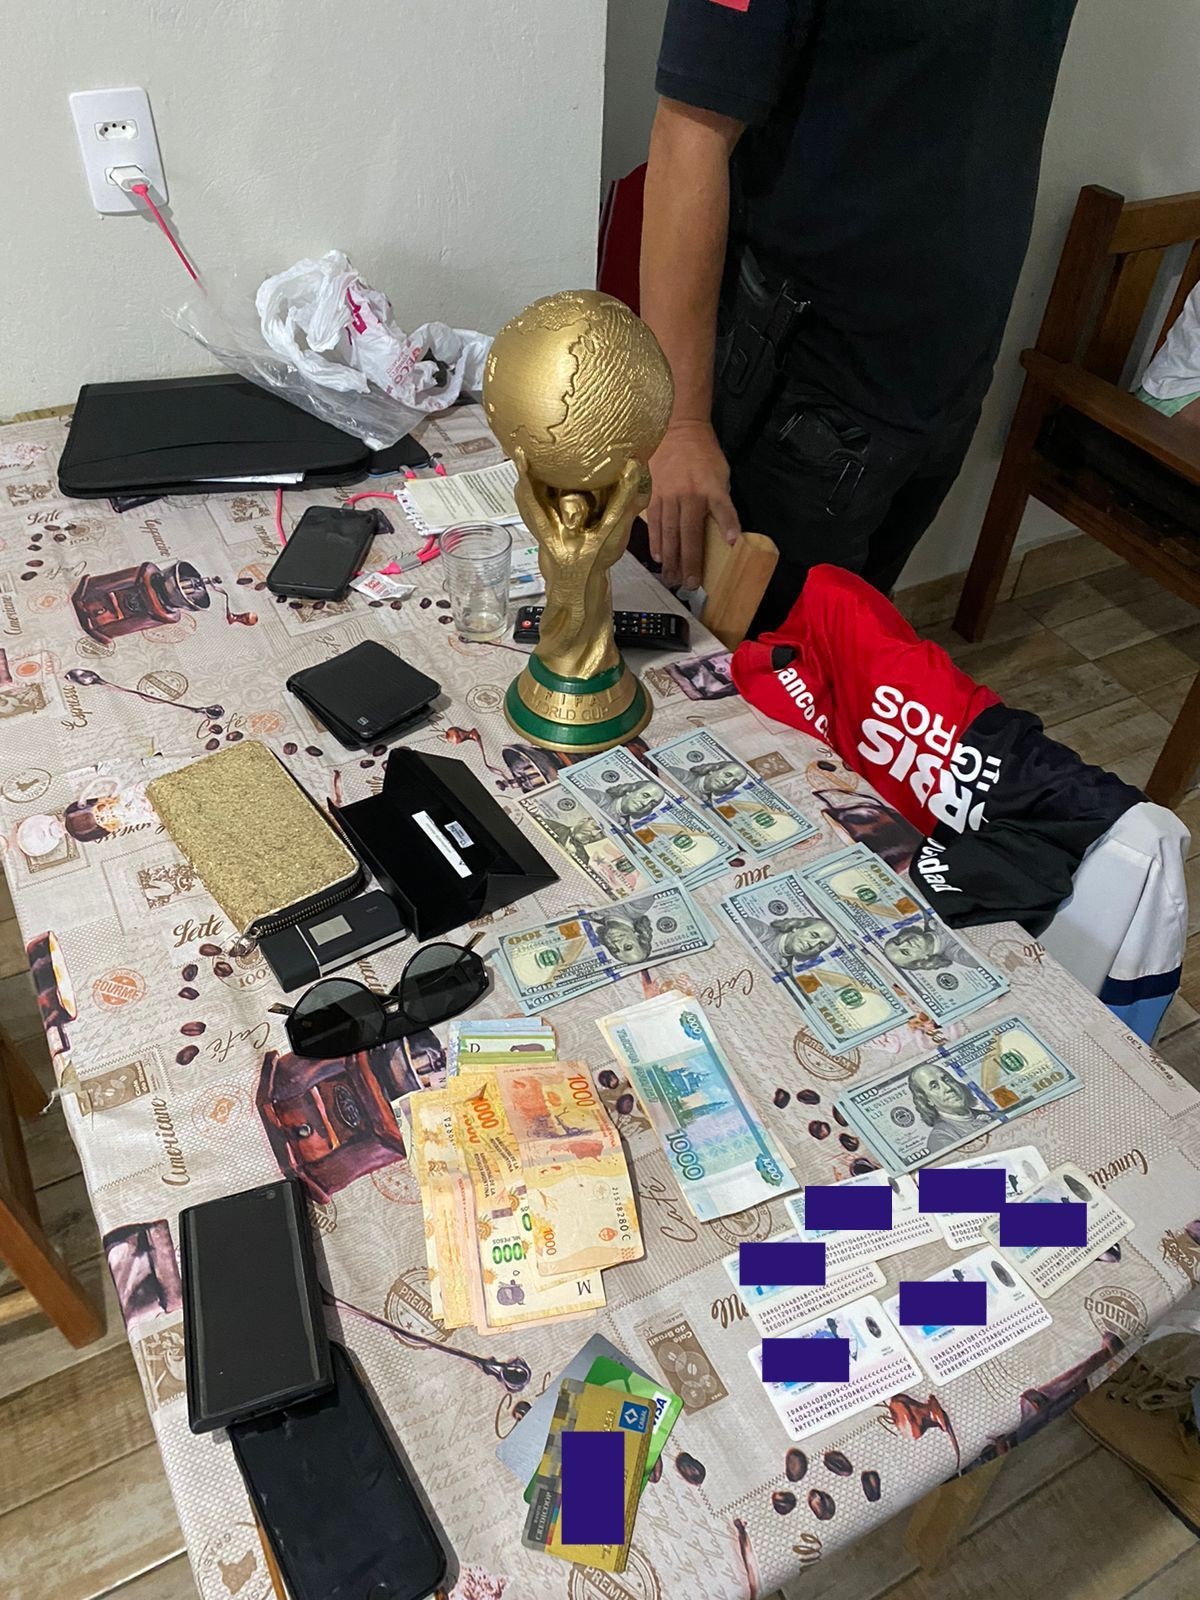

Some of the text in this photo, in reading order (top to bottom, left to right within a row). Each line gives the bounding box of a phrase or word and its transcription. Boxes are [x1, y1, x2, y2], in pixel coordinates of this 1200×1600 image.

[776, 667, 815, 721] anco
[196, 713, 247, 739] Cfé
[567, 1072, 596, 1107] 1000
[665, 1128, 705, 1181] 1000
